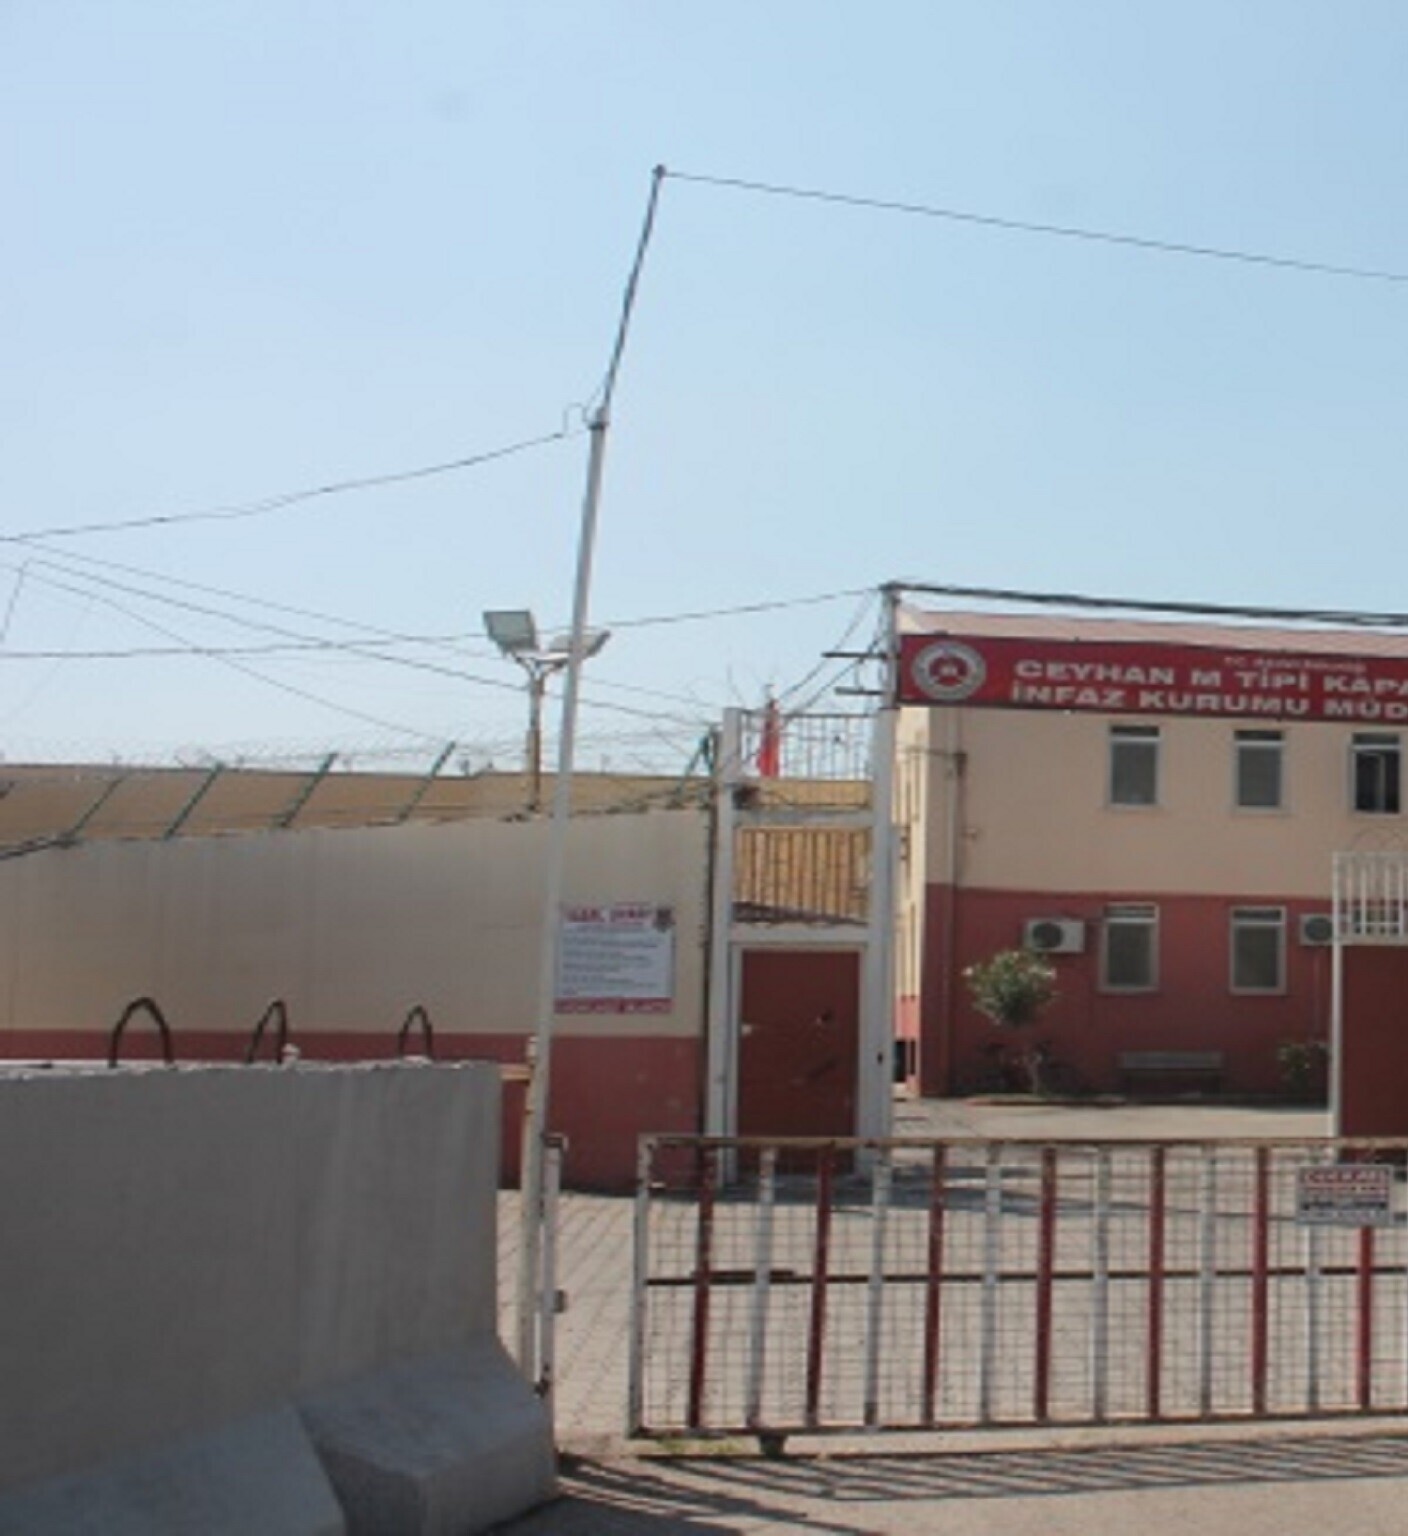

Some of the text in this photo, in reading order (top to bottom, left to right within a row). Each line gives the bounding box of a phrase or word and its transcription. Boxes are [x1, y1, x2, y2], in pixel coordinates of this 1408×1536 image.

[1014, 658, 1175, 686] CEYHAN
[1191, 670, 1222, 687] M
[1233, 667, 1310, 692] TİPİ
[1010, 680, 1126, 709] İNFAZ
[1138, 689, 1310, 716] KURUMU
